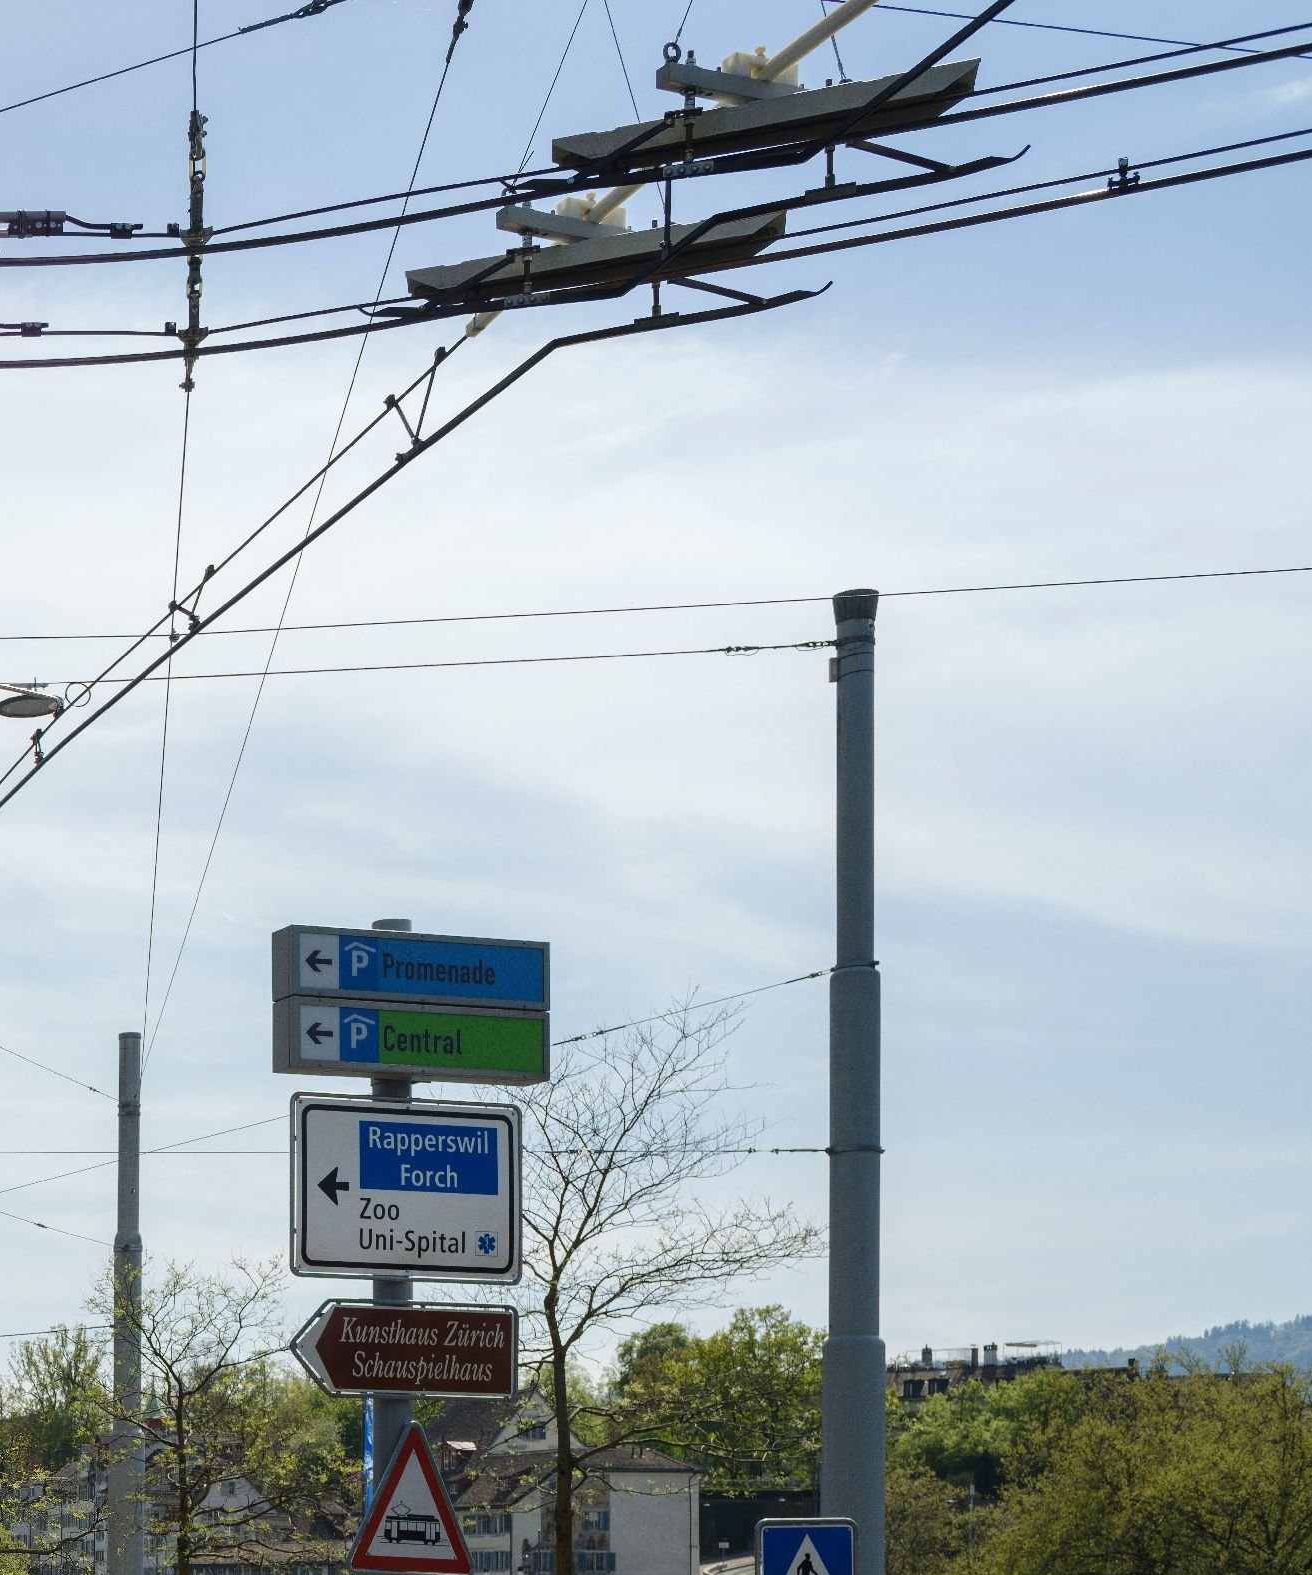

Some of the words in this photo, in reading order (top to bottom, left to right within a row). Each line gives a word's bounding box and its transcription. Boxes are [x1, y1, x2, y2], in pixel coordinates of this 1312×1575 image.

[382, 952, 496, 986] Promenade
[382, 1024, 463, 1056] Central
[367, 1126, 489, 1157] Rapperswil
[400, 1164, 458, 1188] Forch
[359, 1197, 400, 1220] Zoo
[359, 1228, 466, 1258] Uni-Spital
[339, 1317, 438, 1346] Kunsthaus
[443, 1320, 505, 1349] Zürich
[352, 1350, 493, 1385] Schauspielhaus
